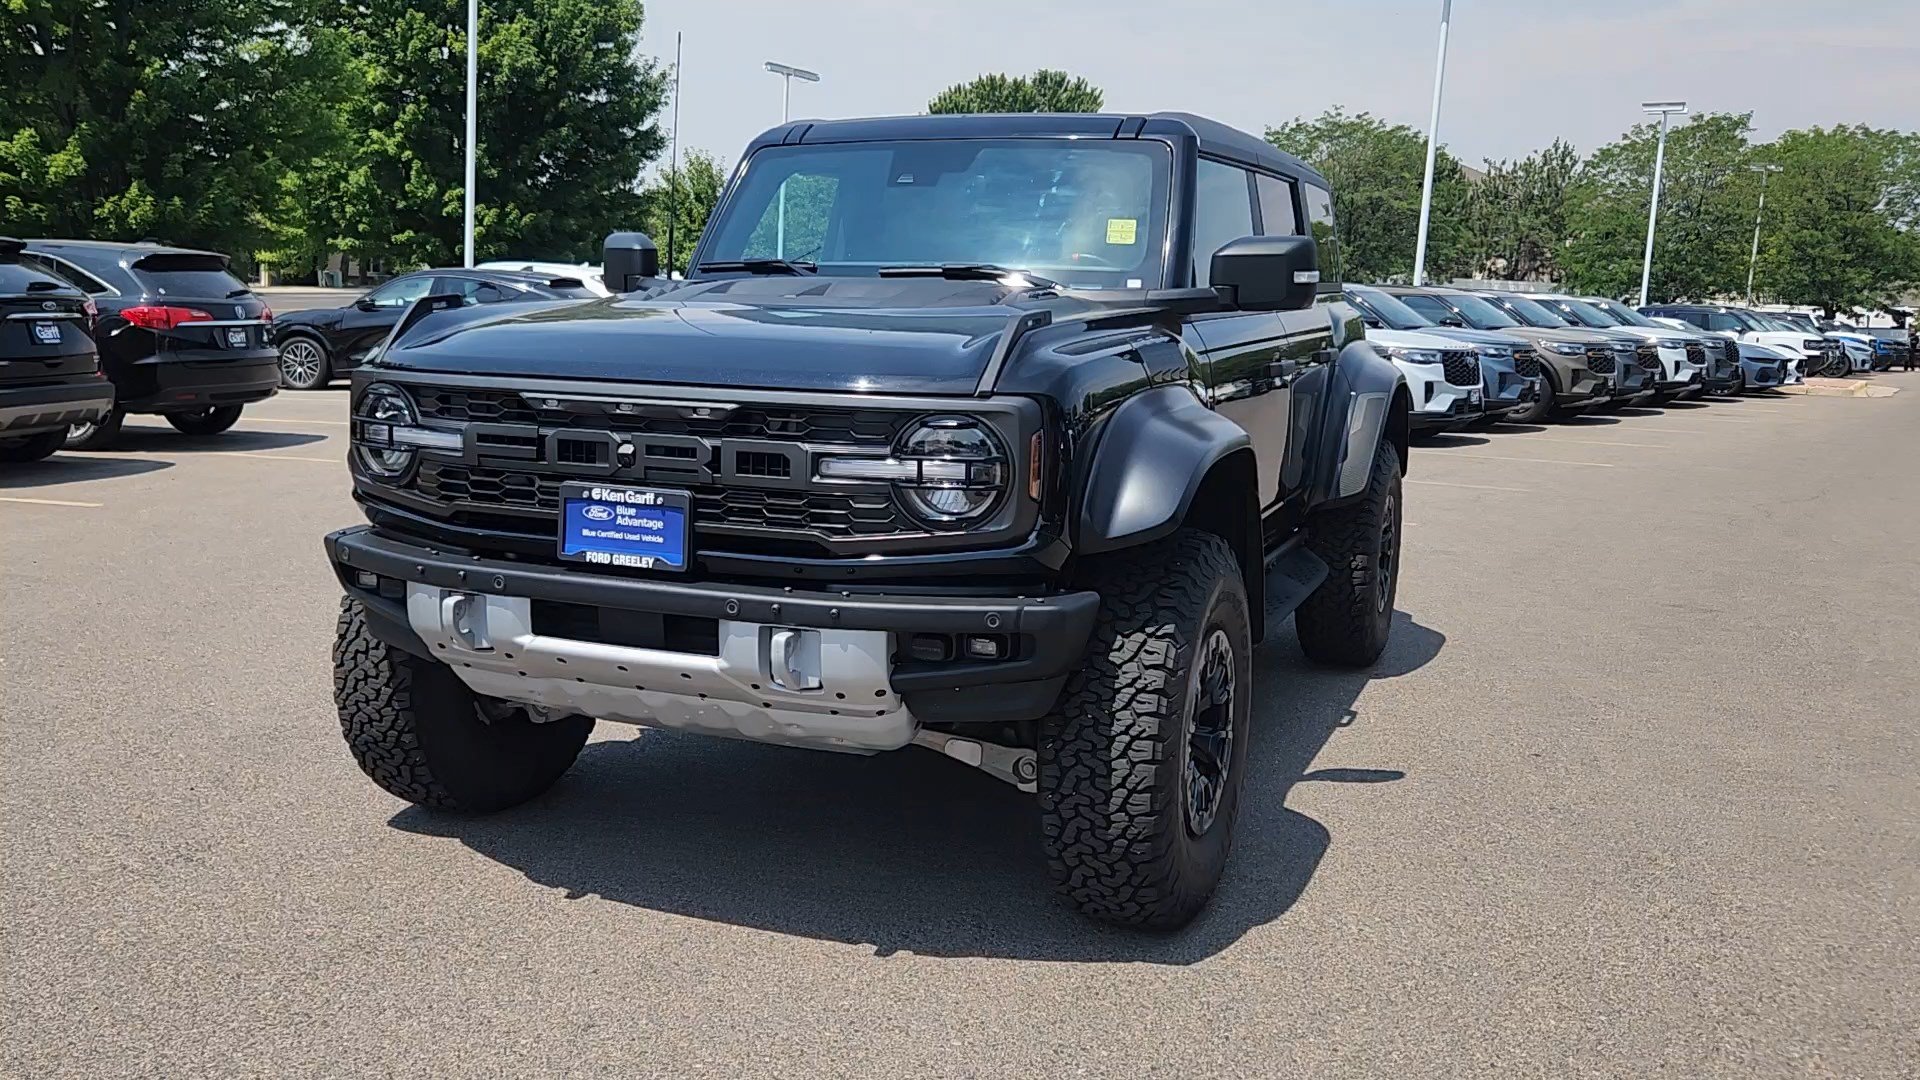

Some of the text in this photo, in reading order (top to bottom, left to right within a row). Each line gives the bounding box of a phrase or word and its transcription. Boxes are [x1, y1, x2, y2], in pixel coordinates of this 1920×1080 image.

[465, 421, 811, 489] FORD
[625, 490, 655, 505] Garff
[589, 507, 609, 518] Ford
[616, 505, 636, 515] Blue
[616, 516, 664, 530] Advantage
[582, 528, 664, 544] Blue Certified Used Vehicle
[586, 551, 655, 569] FORD GREELEY
